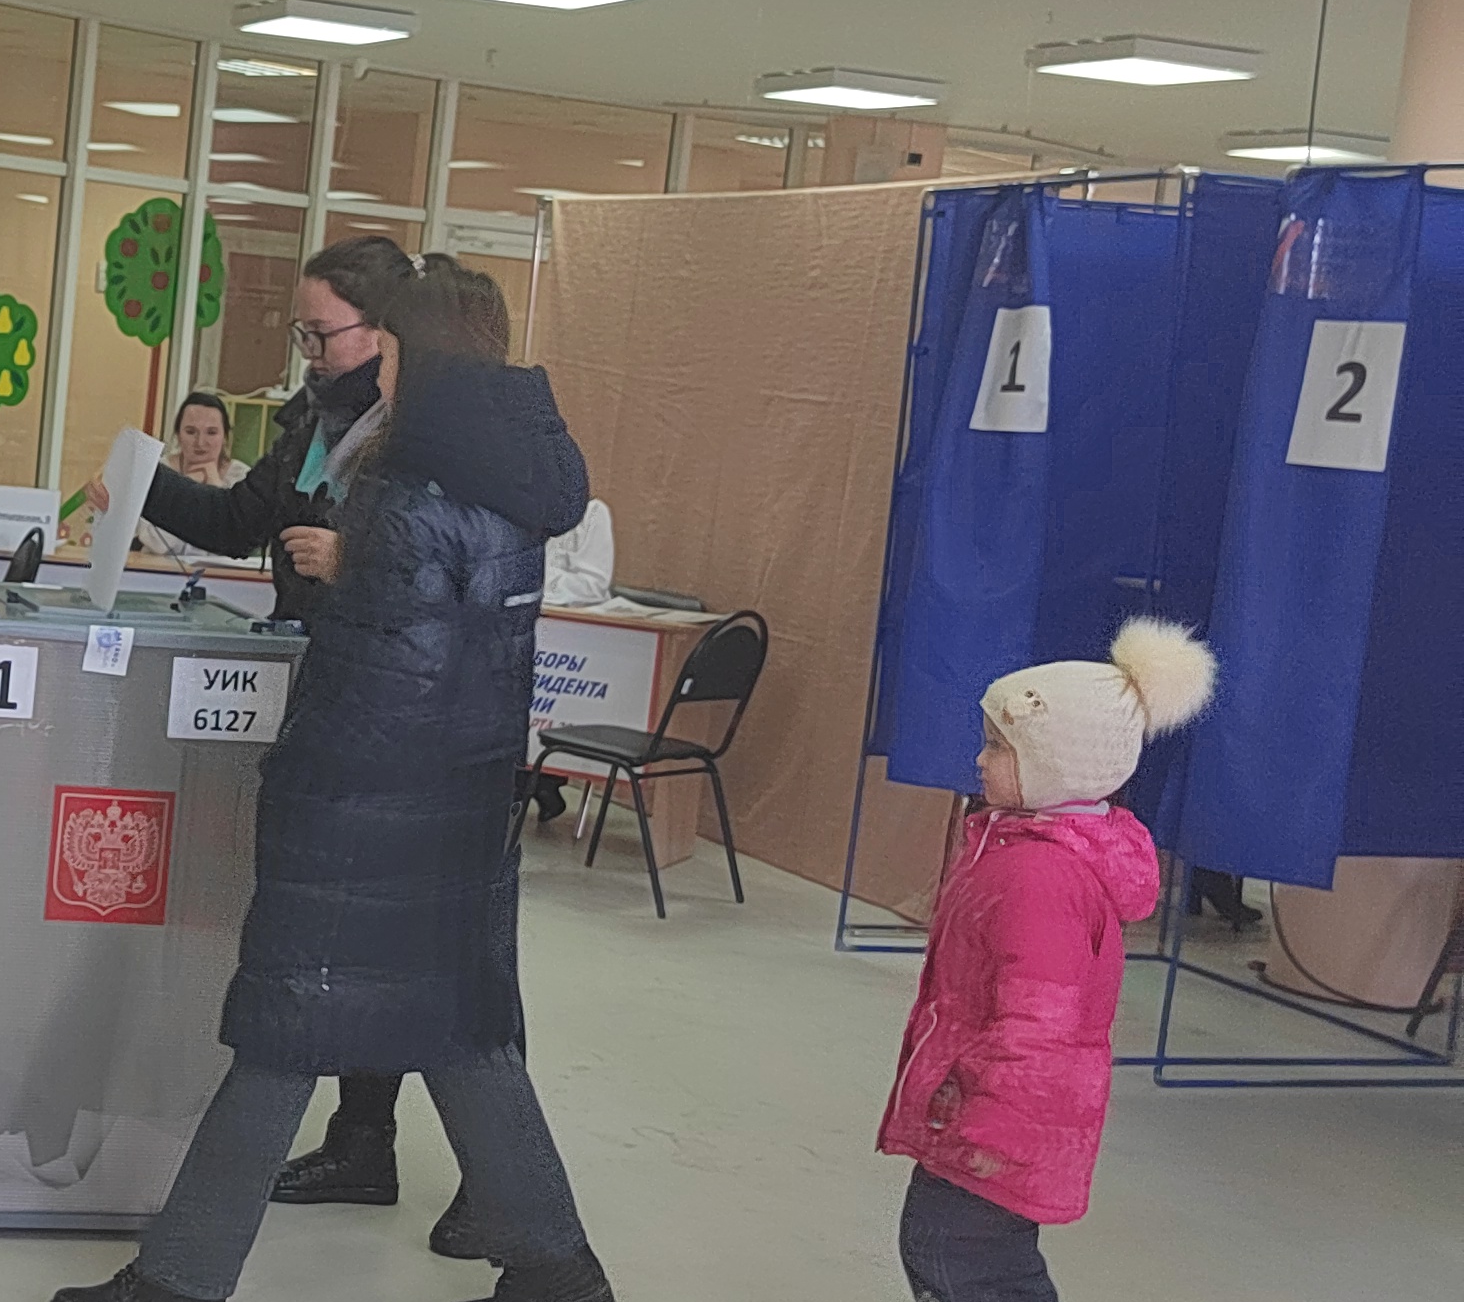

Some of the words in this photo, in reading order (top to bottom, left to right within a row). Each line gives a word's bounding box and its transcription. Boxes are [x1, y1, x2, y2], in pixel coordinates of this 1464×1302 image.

[998, 339, 1026, 393] 1
[1324, 360, 1368, 424] 2
[534, 650, 588, 673] БОРЫ
[203, 668, 259, 693] УИК
[534, 673, 609, 699] ИДЕНТА
[193, 708, 258, 734] 6127
